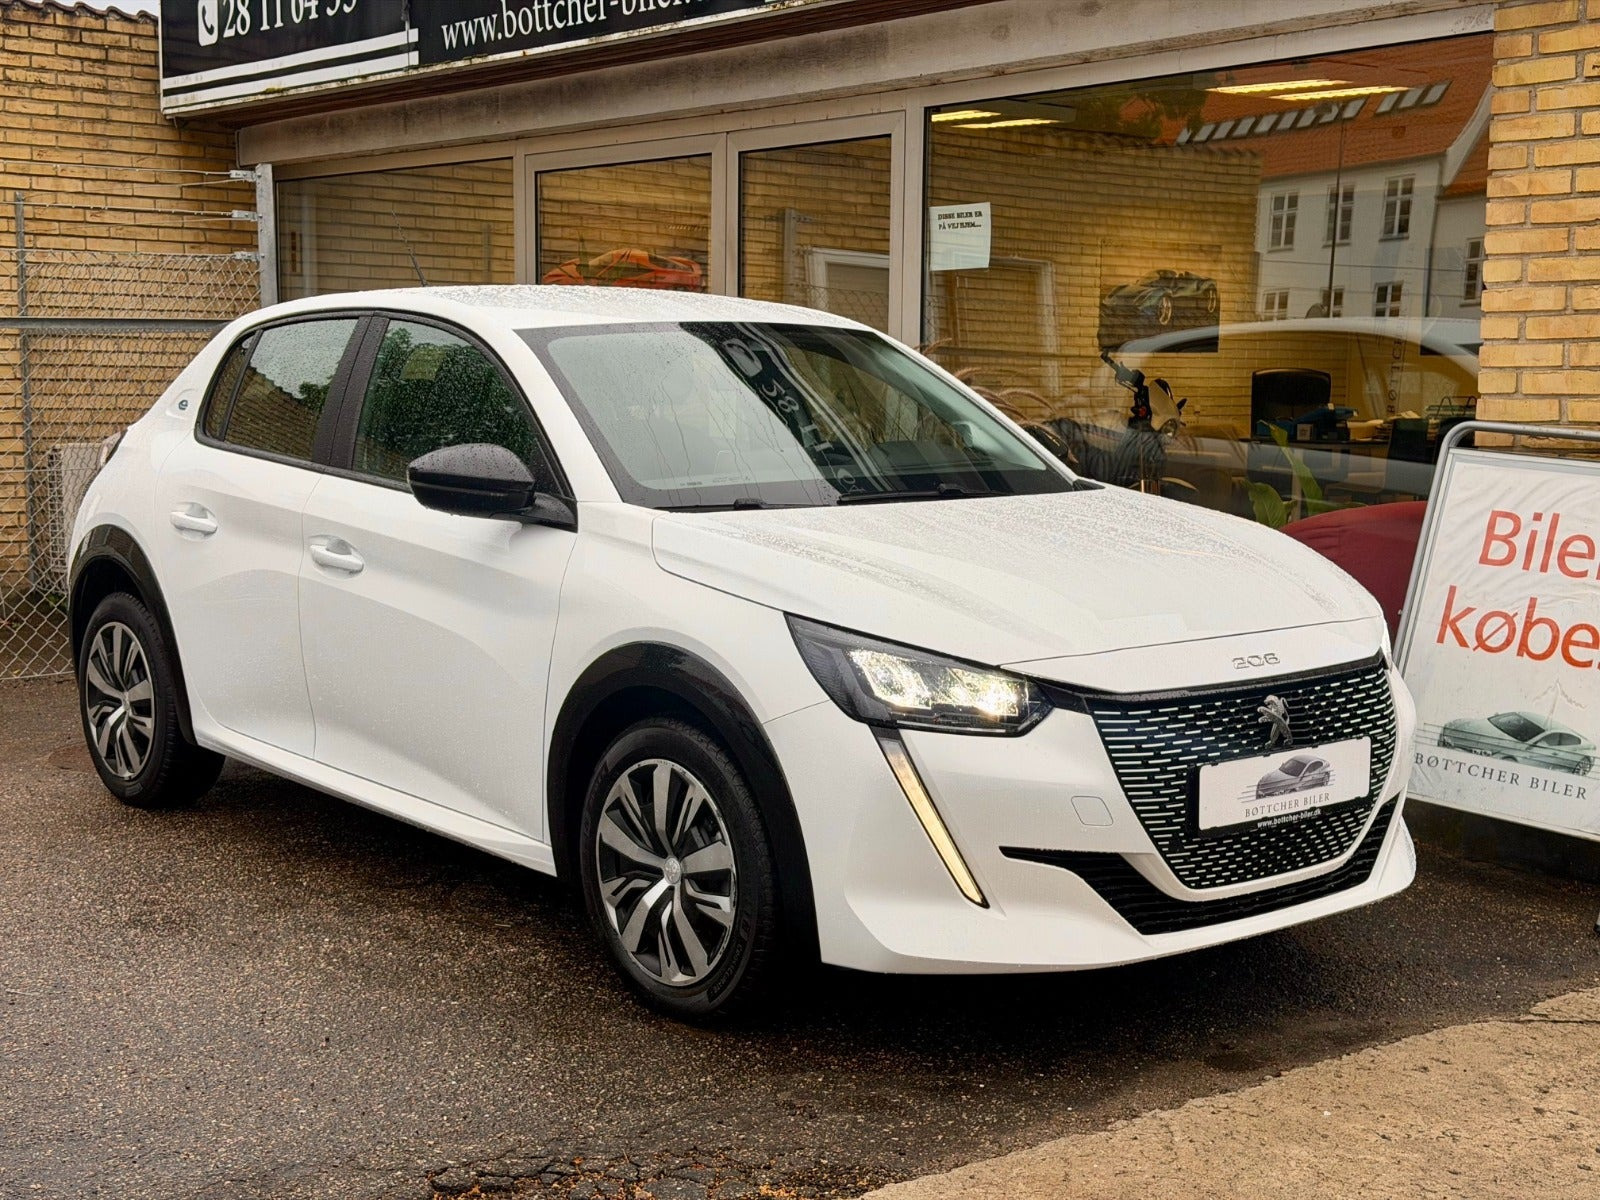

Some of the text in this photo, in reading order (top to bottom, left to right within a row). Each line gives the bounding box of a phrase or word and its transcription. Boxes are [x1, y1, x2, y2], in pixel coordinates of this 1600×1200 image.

[222, 0, 251, 38] 28
[259, 0, 284, 31] 11
[1436, 584, 1600, 671] købe
[1413, 752, 1588, 801] BØTTCHER BILER
[1303, 792, 1331, 806] BILER
